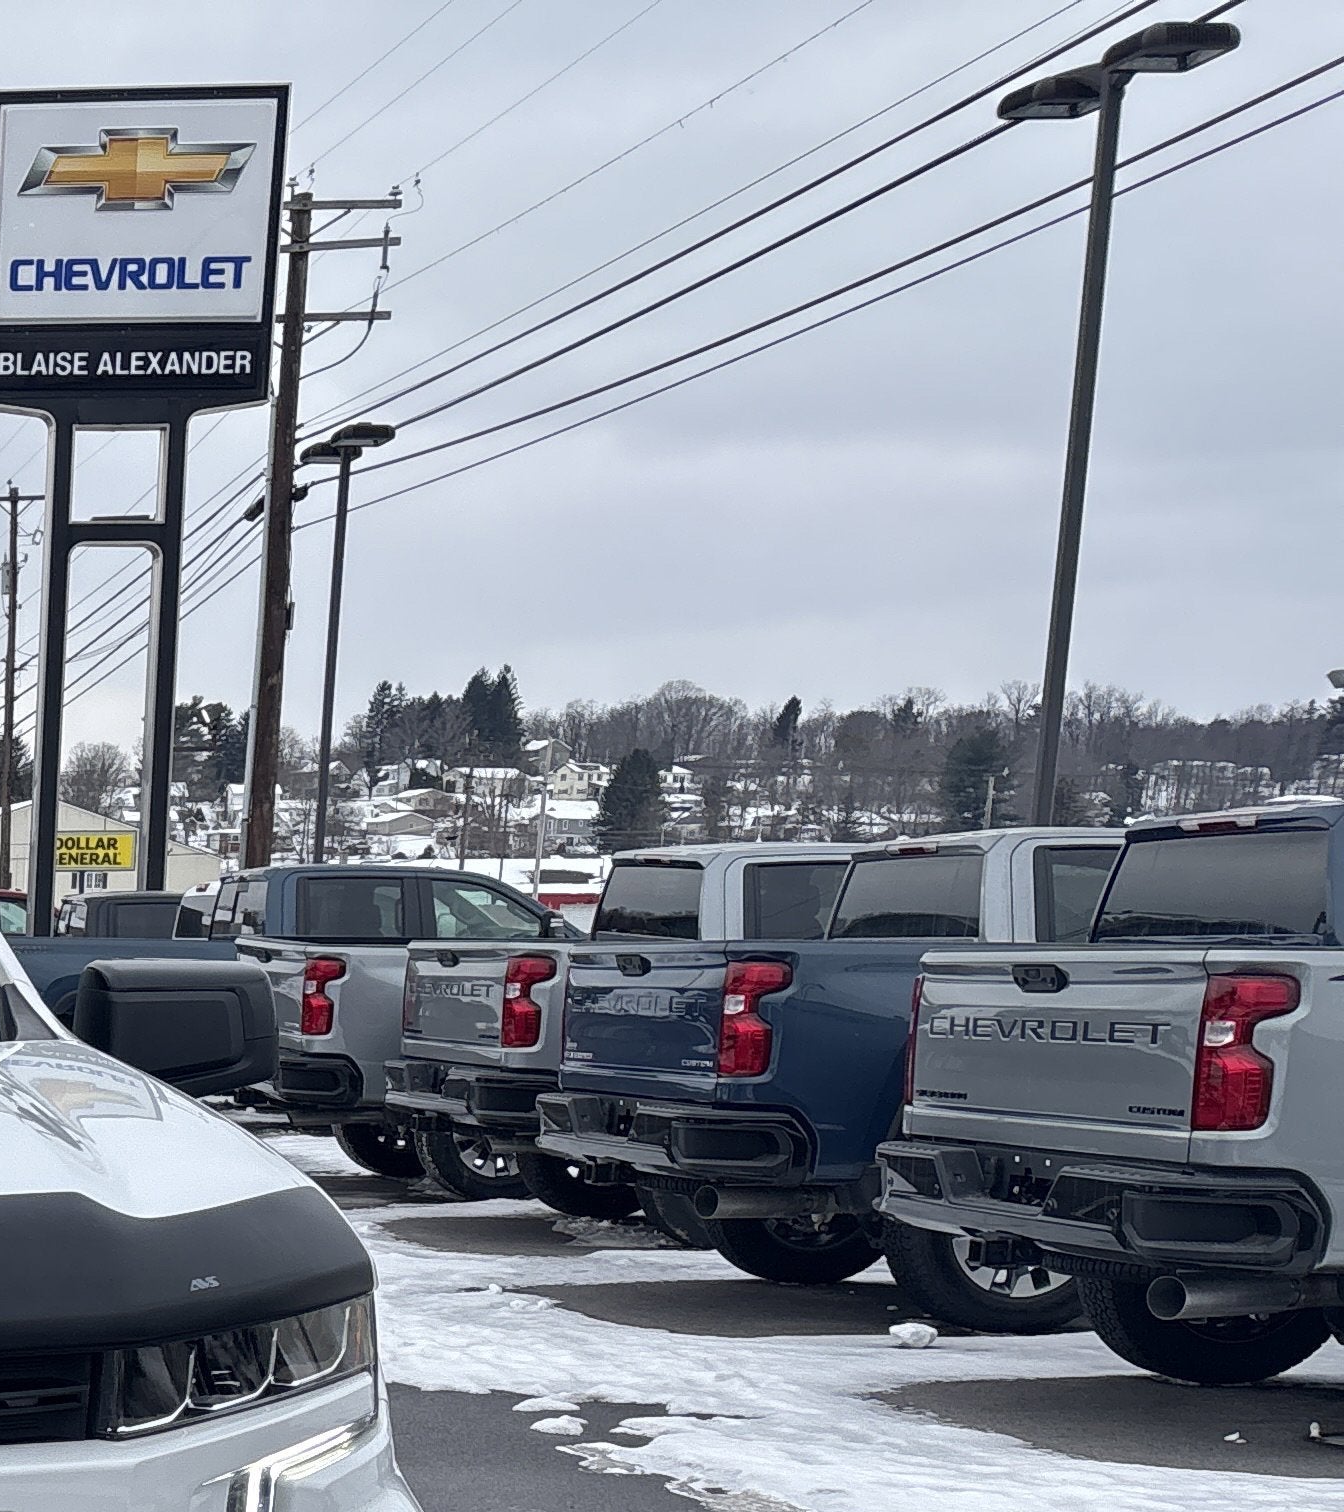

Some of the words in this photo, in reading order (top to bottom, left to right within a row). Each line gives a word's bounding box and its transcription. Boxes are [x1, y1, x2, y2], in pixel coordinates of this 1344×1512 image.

[10, 257, 251, 291] CHEVROLET
[96, 351, 252, 375] ALEXANDER
[57, 837, 118, 850] DOLLAR
[56, 852, 122, 865] ENERAL
[928, 1016, 1171, 1045] CHEVROLET
[191, 1276, 220, 1291] AVS
